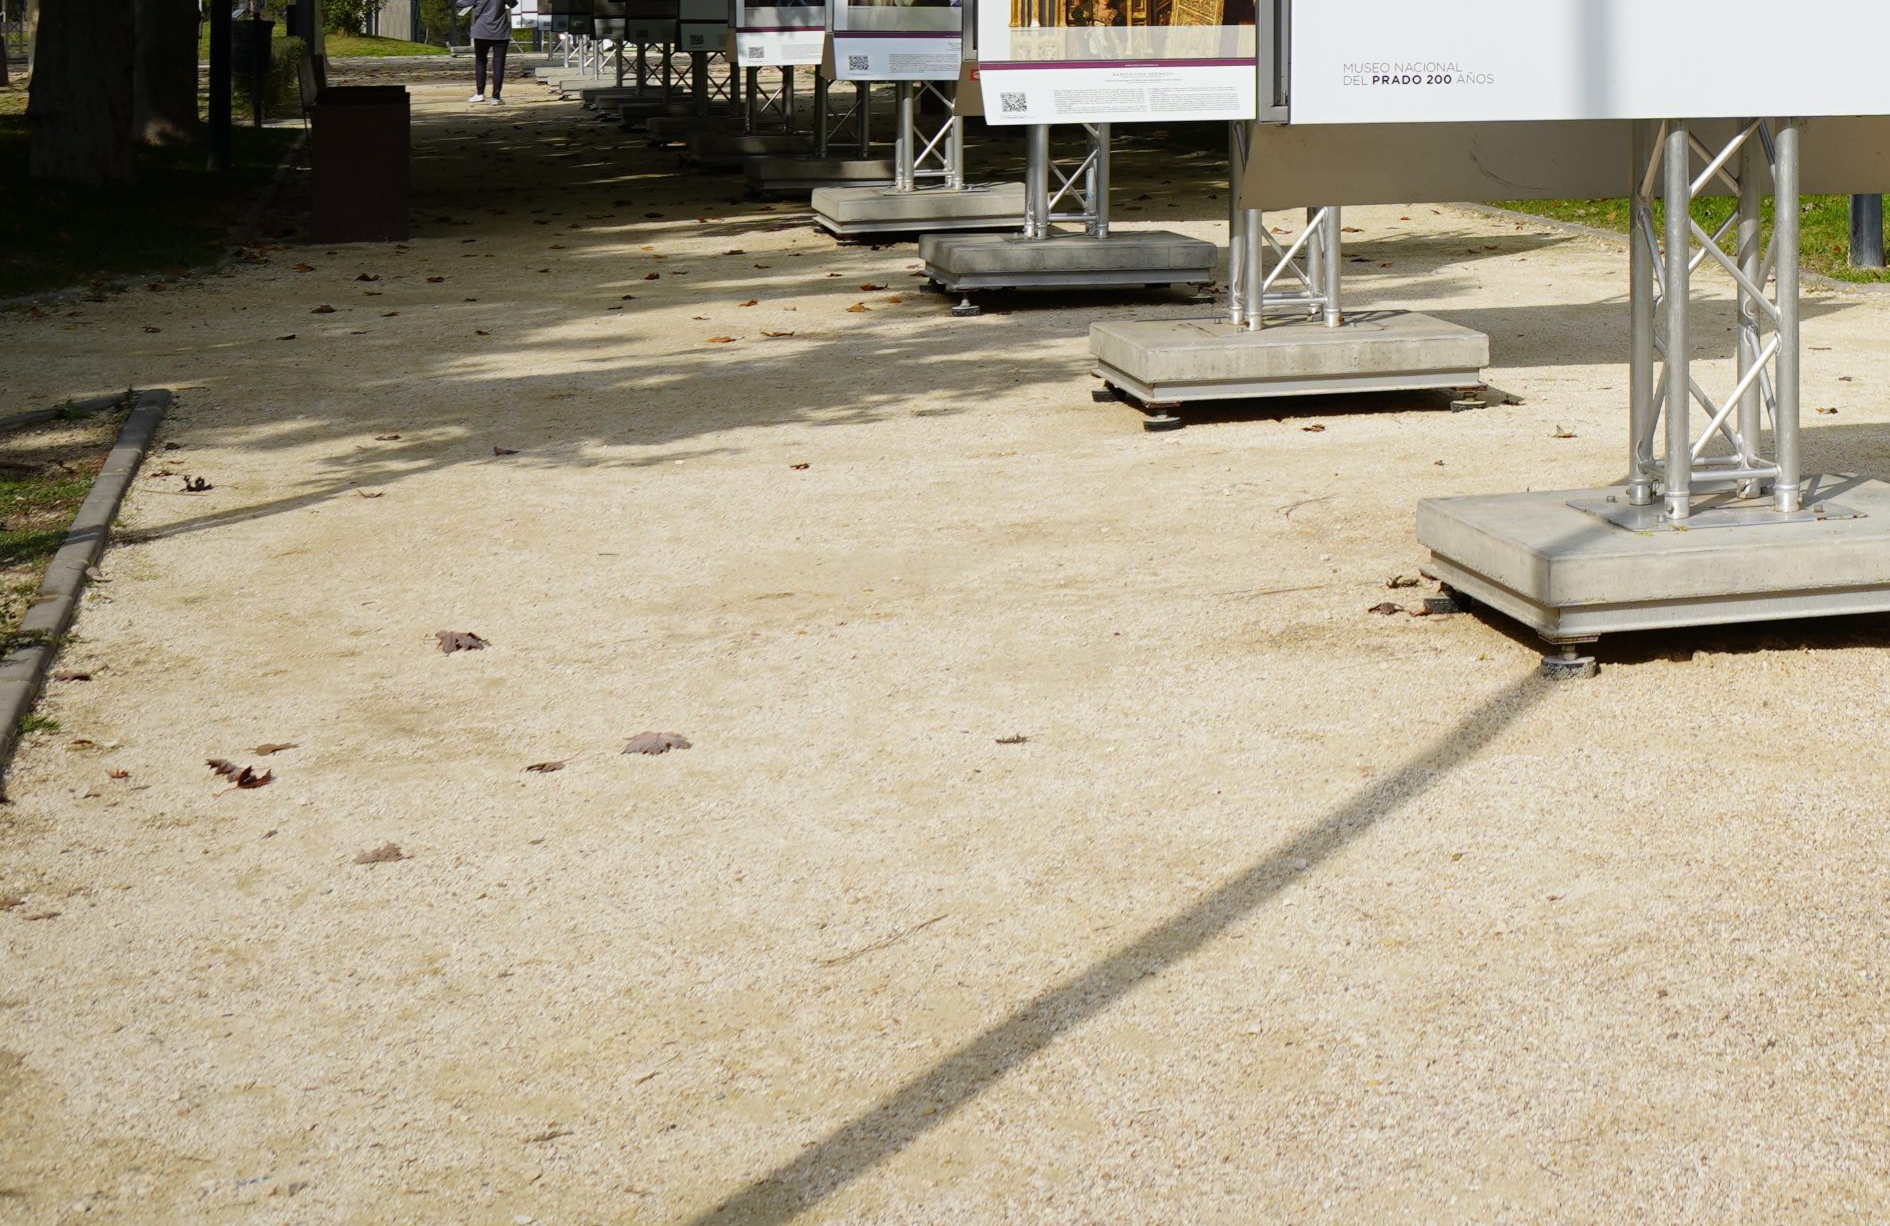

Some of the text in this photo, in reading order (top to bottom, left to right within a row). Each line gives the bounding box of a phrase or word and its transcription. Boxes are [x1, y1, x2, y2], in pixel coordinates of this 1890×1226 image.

[1344, 62, 1462, 73] MUSEO NACIONAL
[1344, 72, 1494, 85] DEL PRADO 200 AÑOS
